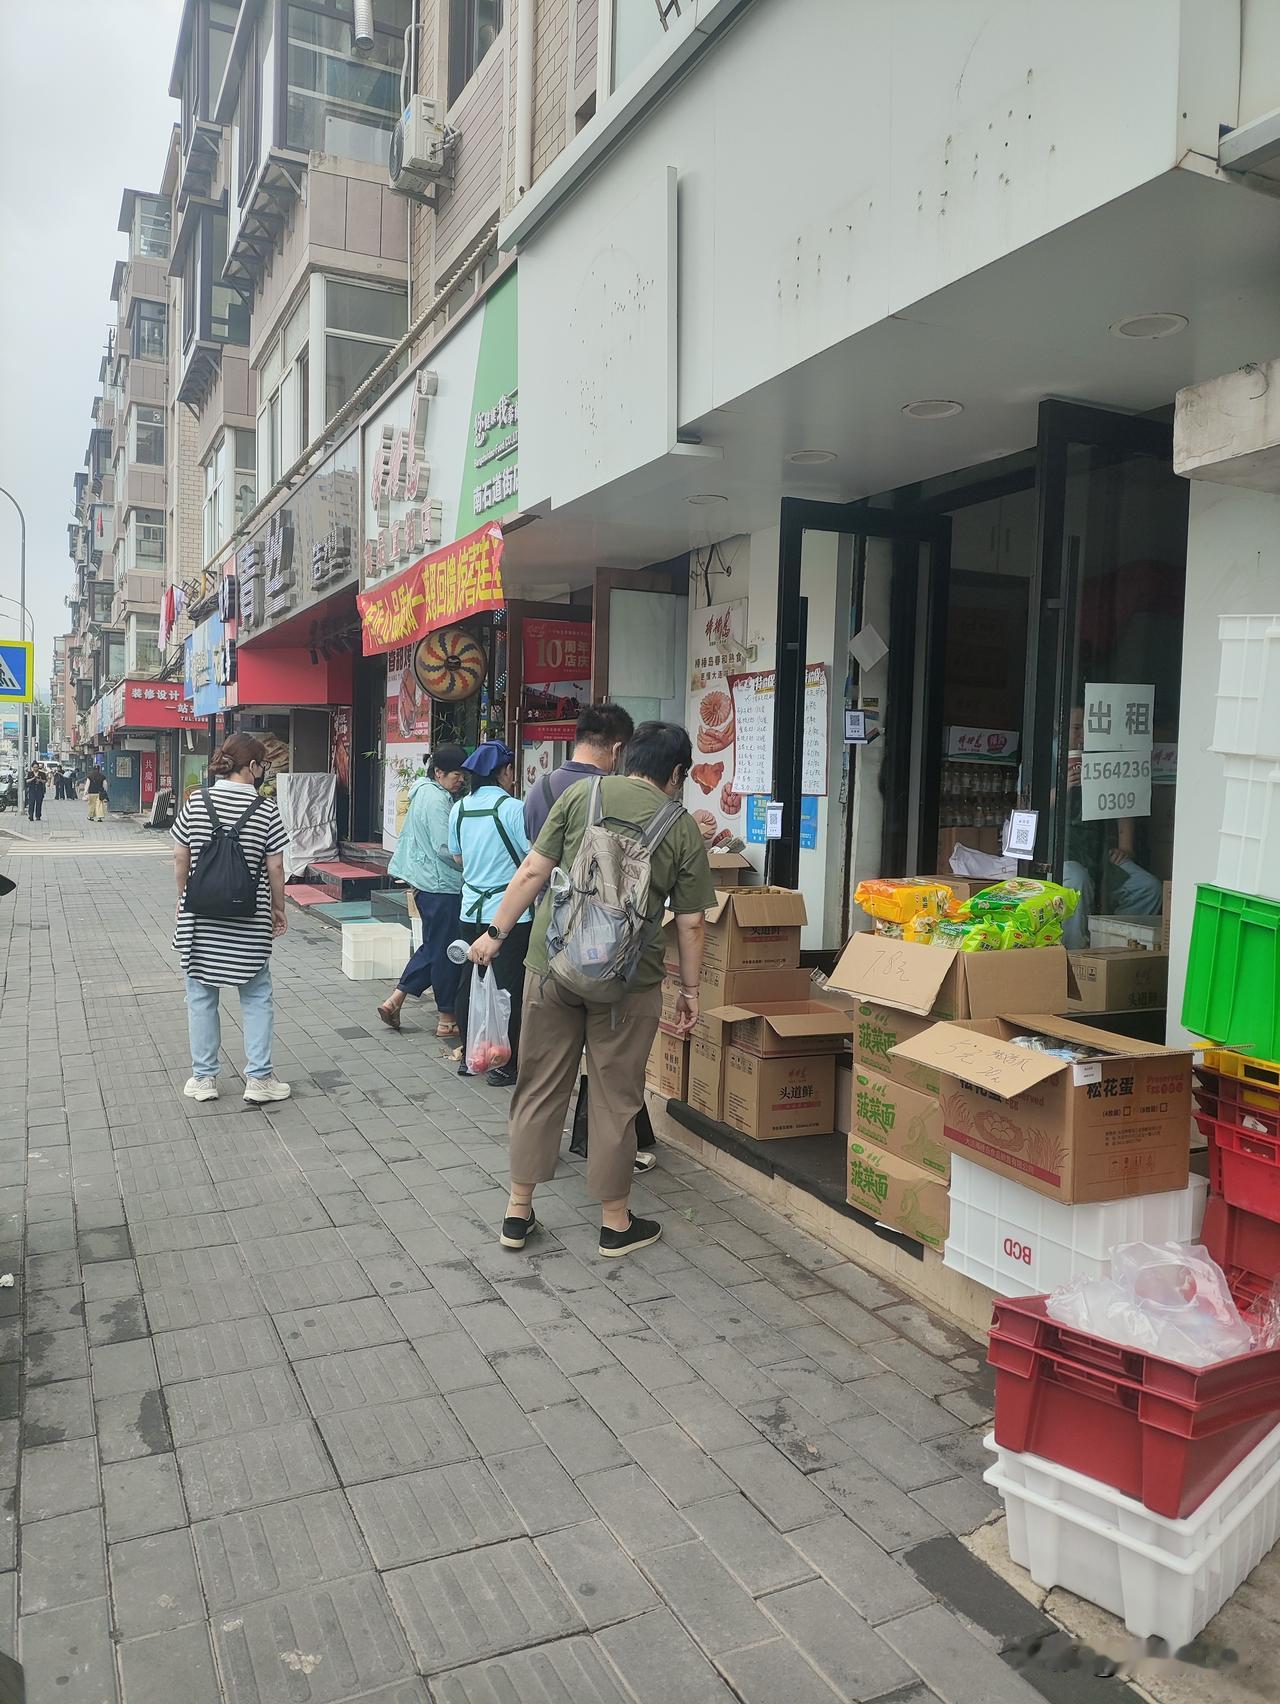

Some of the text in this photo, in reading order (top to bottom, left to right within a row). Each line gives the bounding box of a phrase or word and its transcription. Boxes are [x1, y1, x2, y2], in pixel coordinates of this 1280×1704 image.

[131, 688, 180, 701] 装修设计
[1088, 700, 1151, 736] 出租
[1083, 761, 1150, 780] 1564236
[1098, 792, 1136, 811] 0309
[779, 1085, 814, 1101] 头道鲜
[1086, 1077, 1134, 1099] 松花蛋
[856, 1092, 896, 1134] 菠菜面
[850, 1160, 889, 1204] 菠菜面
[1003, 1237, 1032, 1266] BCD
